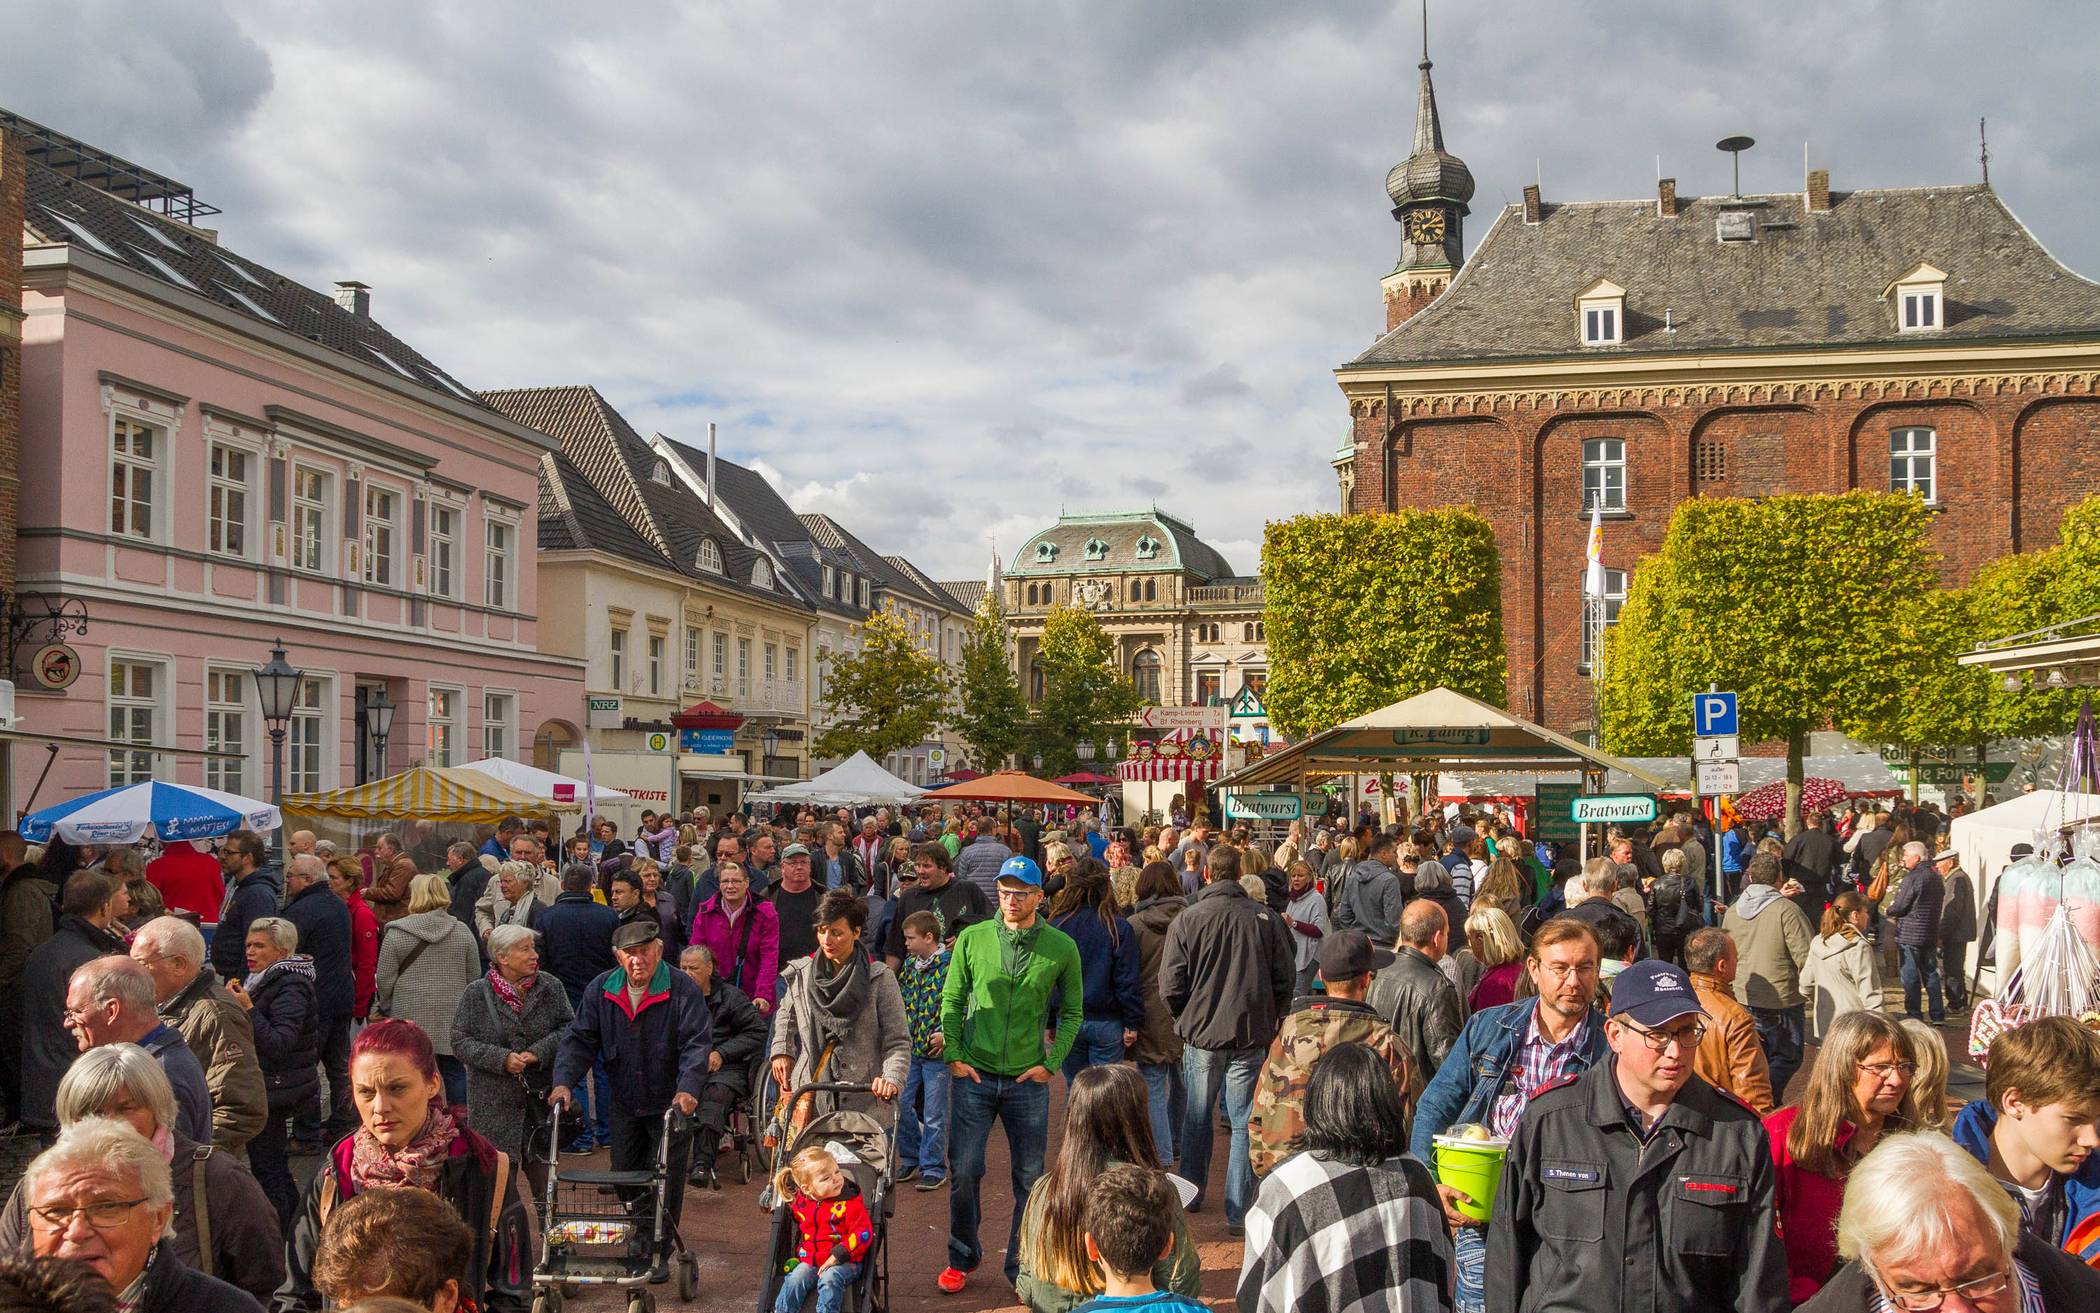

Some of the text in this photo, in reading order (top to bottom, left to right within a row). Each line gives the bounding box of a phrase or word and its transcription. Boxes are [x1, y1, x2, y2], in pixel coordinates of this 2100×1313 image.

[592, 701, 618, 710] NRZ
[1160, 709, 1204, 717] Kamp-Lintfort
[1704, 698, 1727, 731] P
[1170, 718, 1202, 726] Rheinberg
[1880, 744, 1957, 760] Rollasen
[608, 788, 668, 801] STKISTE
[1231, 799, 1297, 815] Bratwurst
[1578, 802, 1650, 818] Bratwurst
[1578, 1172, 1589, 1180] von
